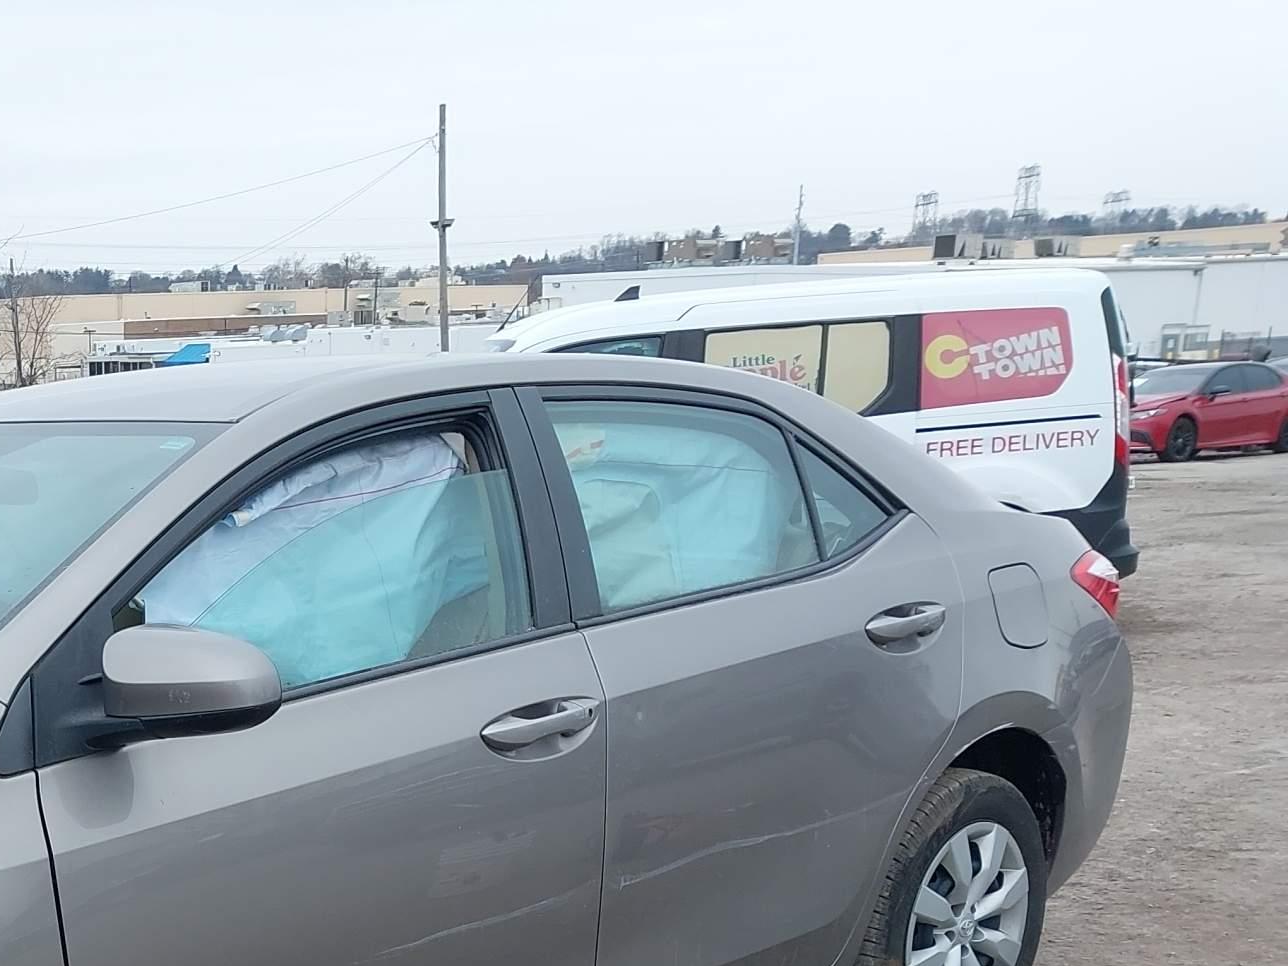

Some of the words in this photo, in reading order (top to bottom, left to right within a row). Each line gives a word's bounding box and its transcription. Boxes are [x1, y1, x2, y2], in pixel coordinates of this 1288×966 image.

[732, 354, 775, 368] Little
[968, 326, 1061, 364] TOWN
[973, 345, 1064, 380] TOWN
[926, 438, 984, 458] FREE
[991, 428, 1100, 455] DELIVERY
